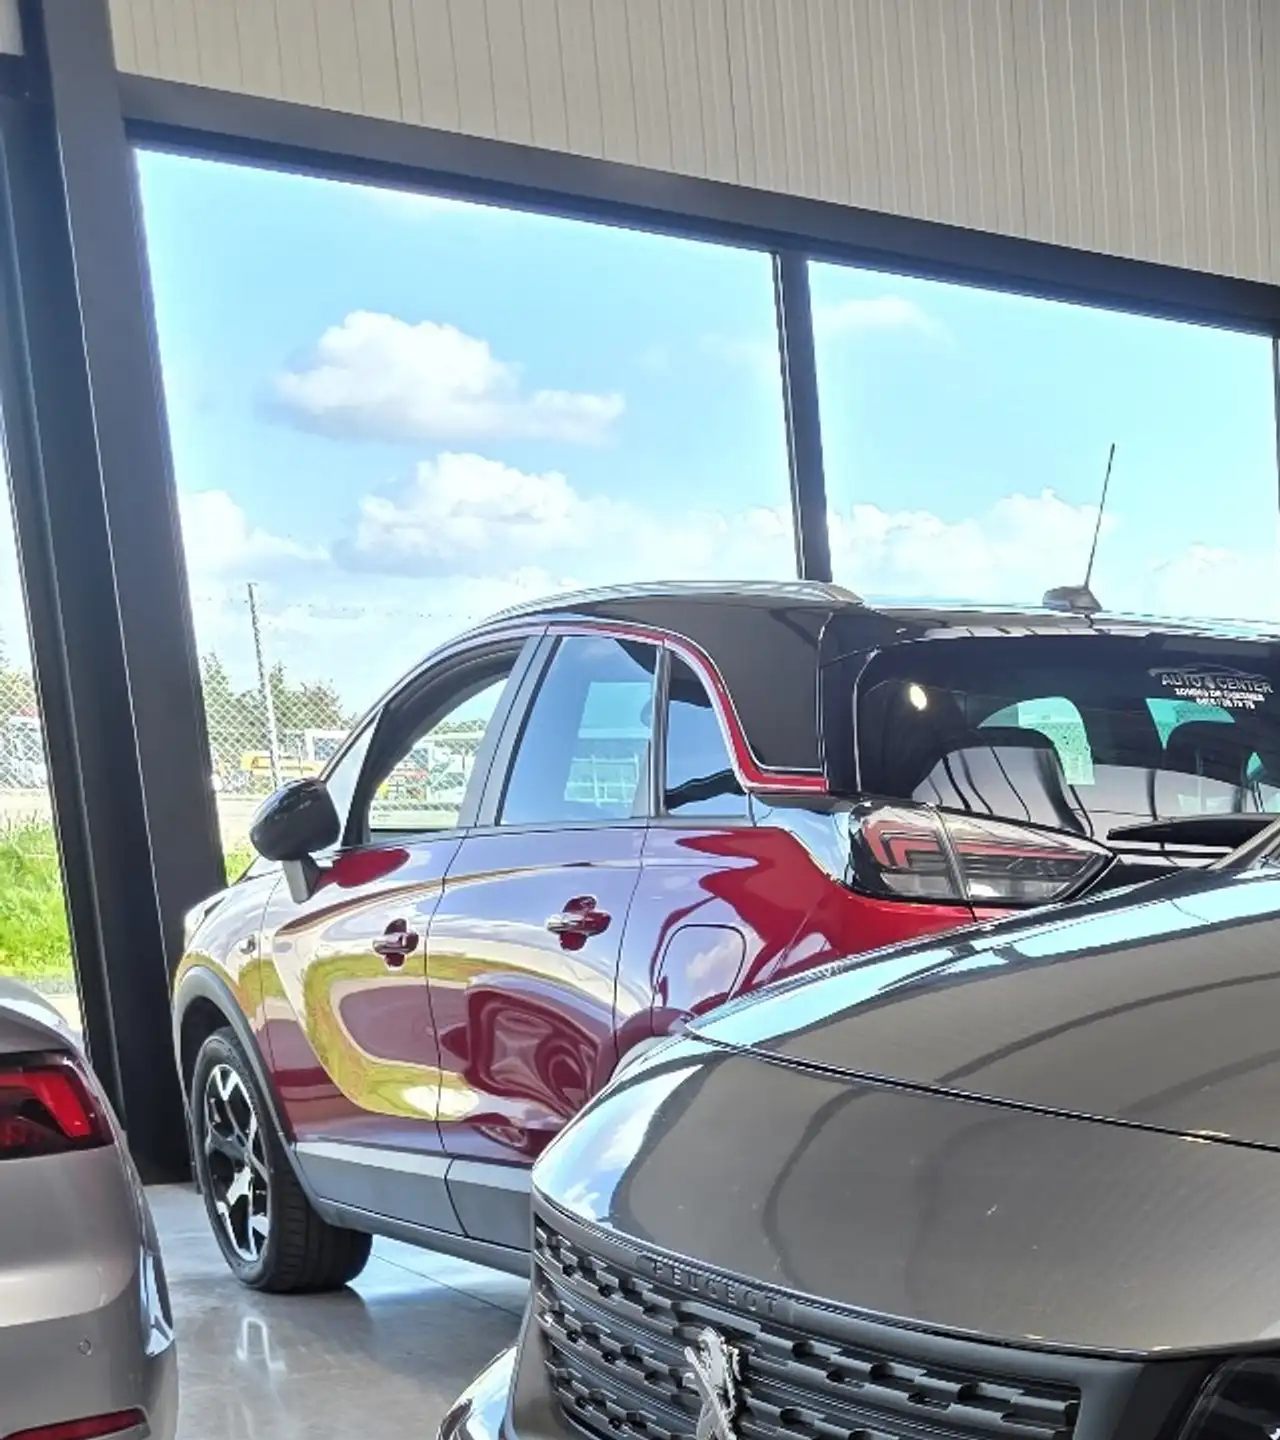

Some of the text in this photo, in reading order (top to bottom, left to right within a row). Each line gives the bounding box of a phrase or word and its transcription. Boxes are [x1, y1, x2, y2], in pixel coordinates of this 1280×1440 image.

[1161, 674, 1201, 688] AUTO
[1216, 678, 1274, 693] CENTER
[652, 1260, 777, 1315] PEUGEOT
